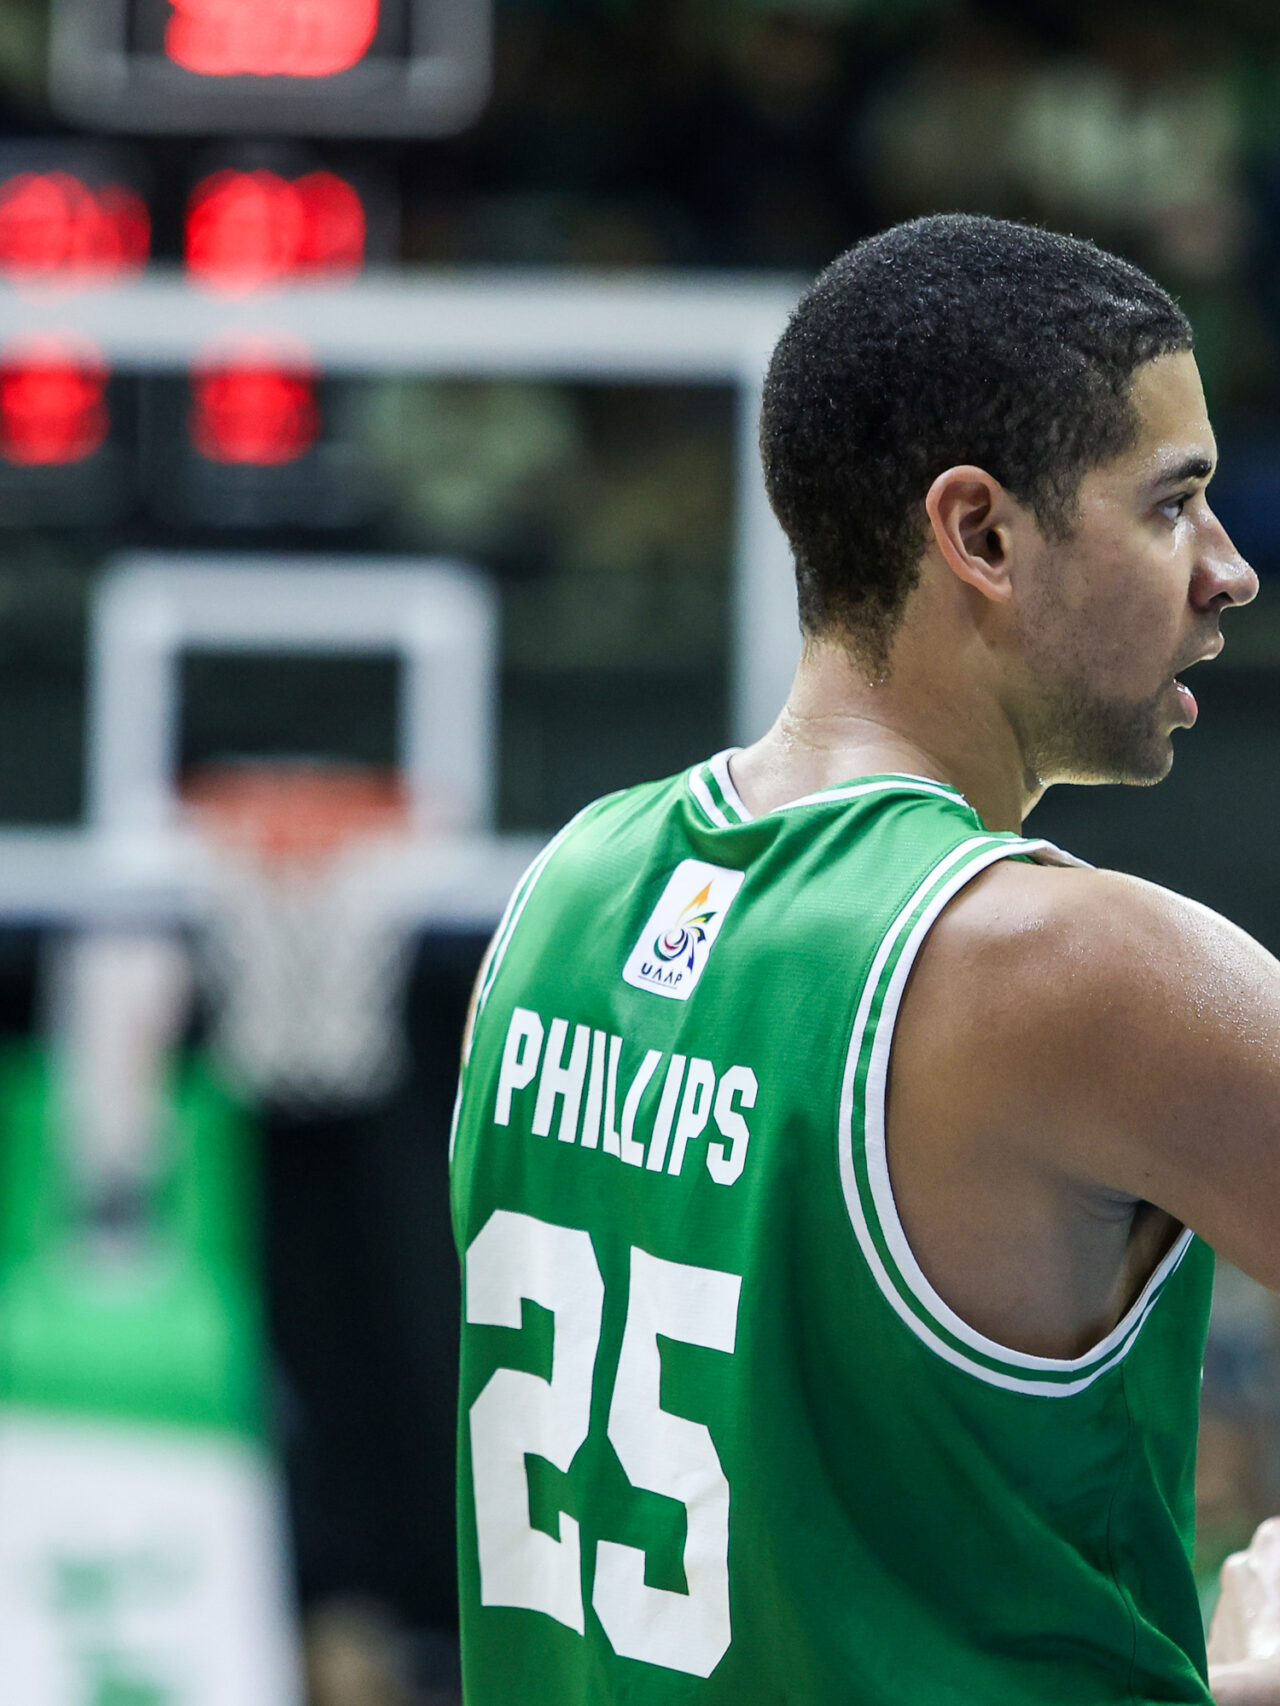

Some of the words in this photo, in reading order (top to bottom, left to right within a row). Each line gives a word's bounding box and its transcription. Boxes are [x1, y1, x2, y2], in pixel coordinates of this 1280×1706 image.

[641, 962, 683, 985] UAAP
[495, 1006, 758, 1184] PHILLIPS
[466, 1209, 741, 1678] 25
